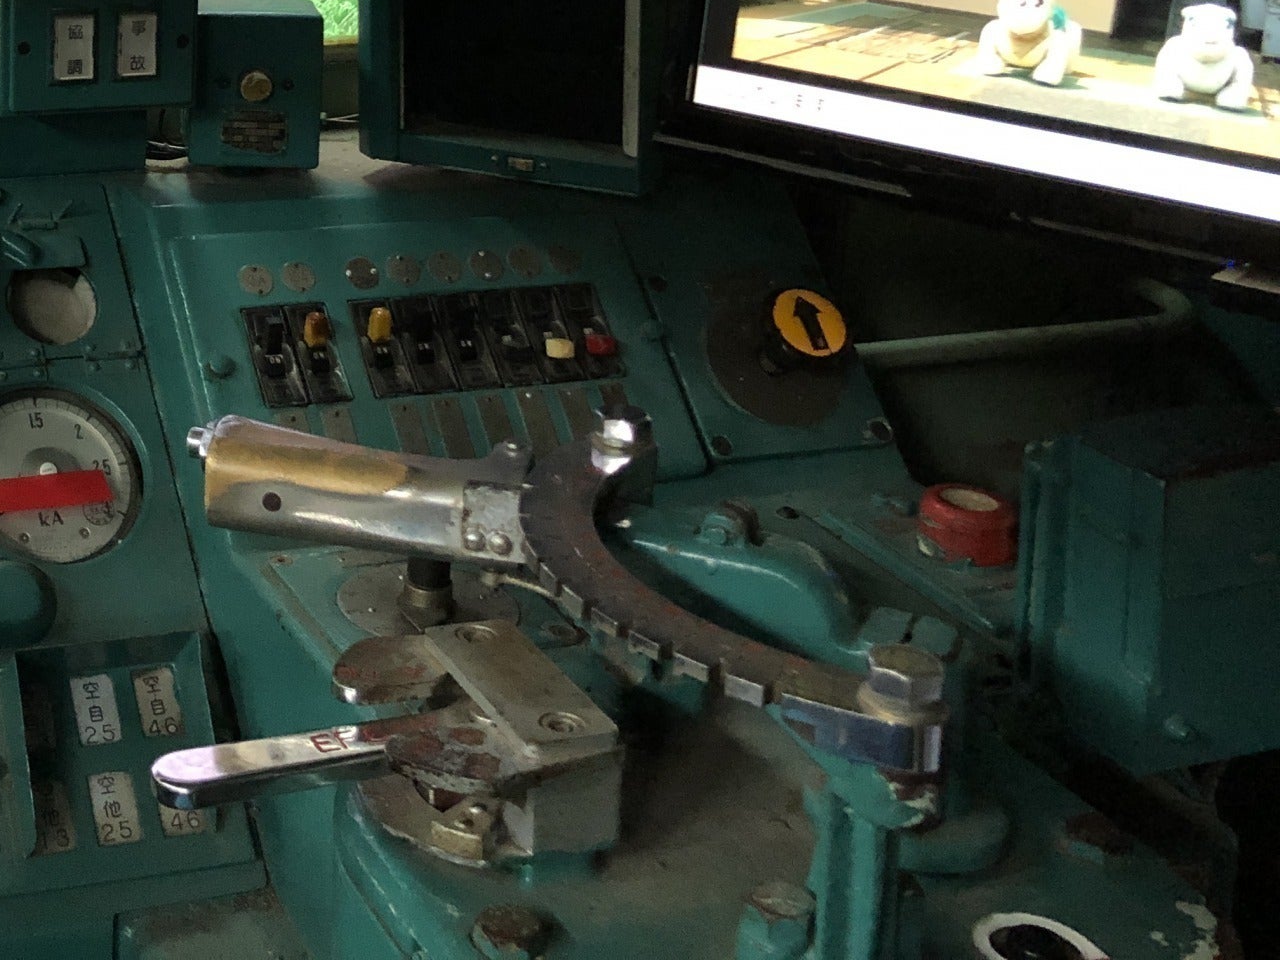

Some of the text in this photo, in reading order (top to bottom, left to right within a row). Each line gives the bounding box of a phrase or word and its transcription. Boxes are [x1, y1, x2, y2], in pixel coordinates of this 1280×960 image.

[67, 24, 84, 75] 協調
[74, 423, 84, 440] 2
[38, 510, 65, 527] kA
[84, 724, 115, 745] 25
[149, 717, 178, 735] 46
[171, 811, 200, 830] 46
[101, 820, 133, 843] 25
